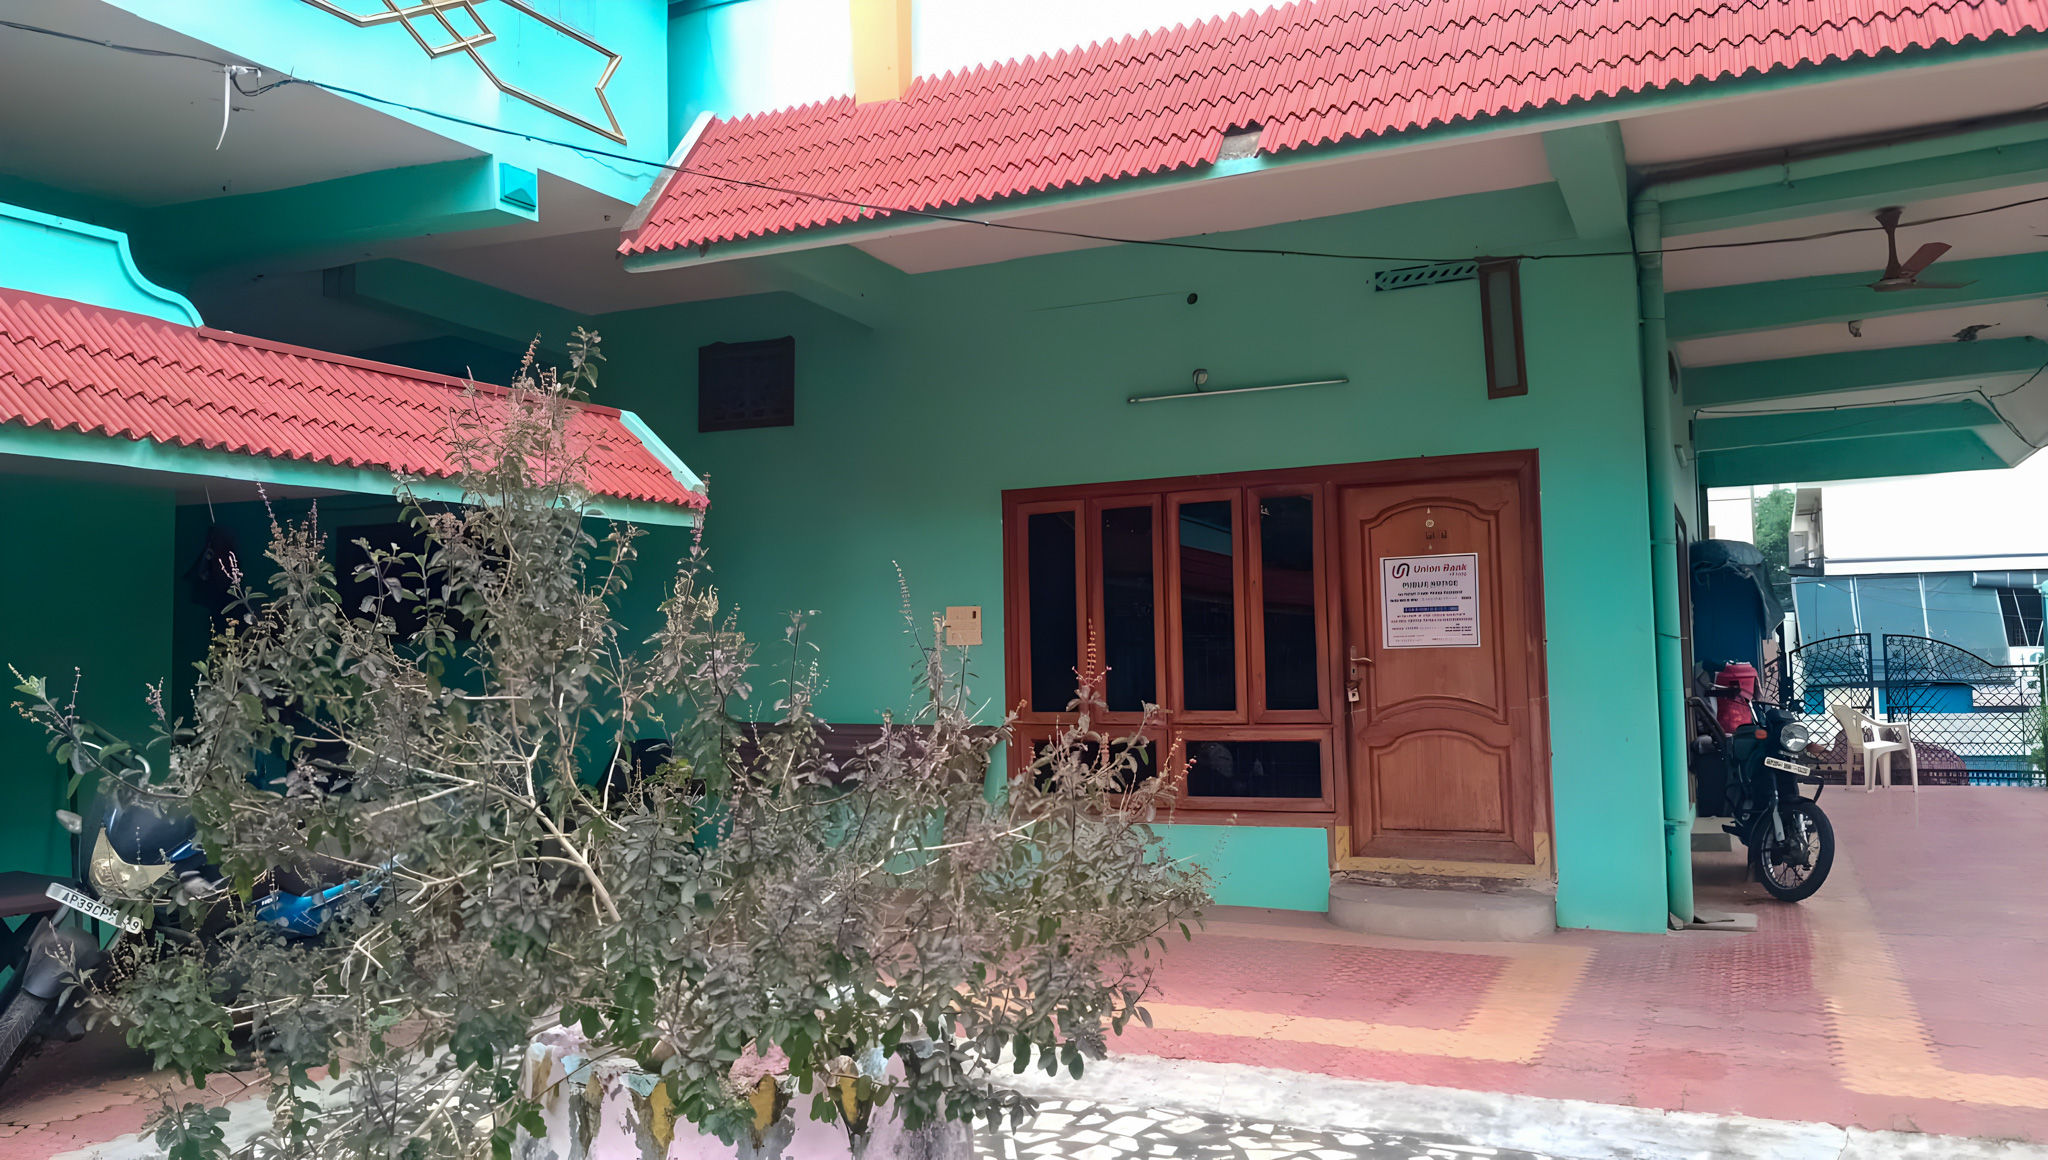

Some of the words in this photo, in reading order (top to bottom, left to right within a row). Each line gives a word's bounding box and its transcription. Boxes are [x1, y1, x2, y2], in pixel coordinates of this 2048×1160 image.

[1414, 565, 1441, 573] Union
[1443, 563, 1467, 572] Bank
[61, 892, 140, 931] AP39CP9
